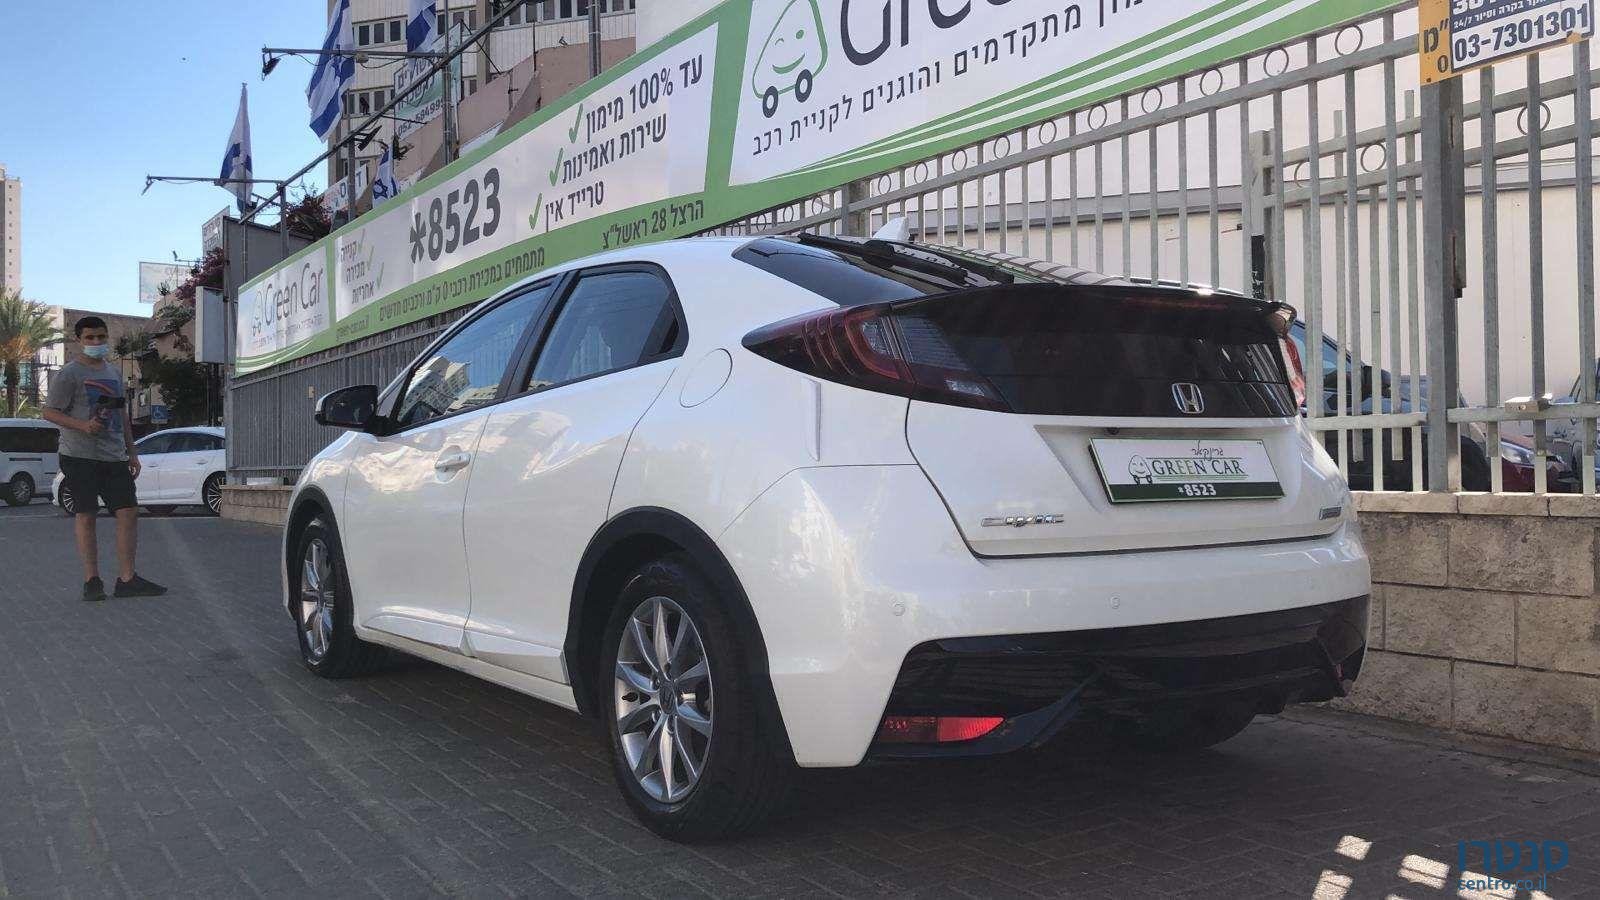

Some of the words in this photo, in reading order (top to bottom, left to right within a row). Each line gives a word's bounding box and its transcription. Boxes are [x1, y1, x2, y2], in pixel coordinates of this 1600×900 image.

[955, 4, 1081, 76] מתקדמים
[1454, 16, 1473, 30] 24/7
[1454, 3, 1589, 62] 03-7301301
[679, 54, 702, 88] עד
[863, 35, 940, 113] והוגנים
[630, 67, 673, 113] 100%
[586, 96, 624, 143] מימון
[619, 114, 667, 156] שירות
[789, 95, 852, 142] לקניית
[753, 127, 782, 156] רכב
[563, 140, 615, 184] ואמינות
[568, 181, 604, 216] טרייד
[671, 200, 704, 229] הרצל
[545, 200, 565, 233] אין
[651, 209, 667, 232] 28
[469, 263, 503, 293] במכירת
[505, 246, 545, 279] מתמחים
[265, 282, 297, 326] Green
[301, 262, 324, 310] Car
[1152, 459, 1207, 476] GREEN
[1211, 459, 1245, 475] CAR
